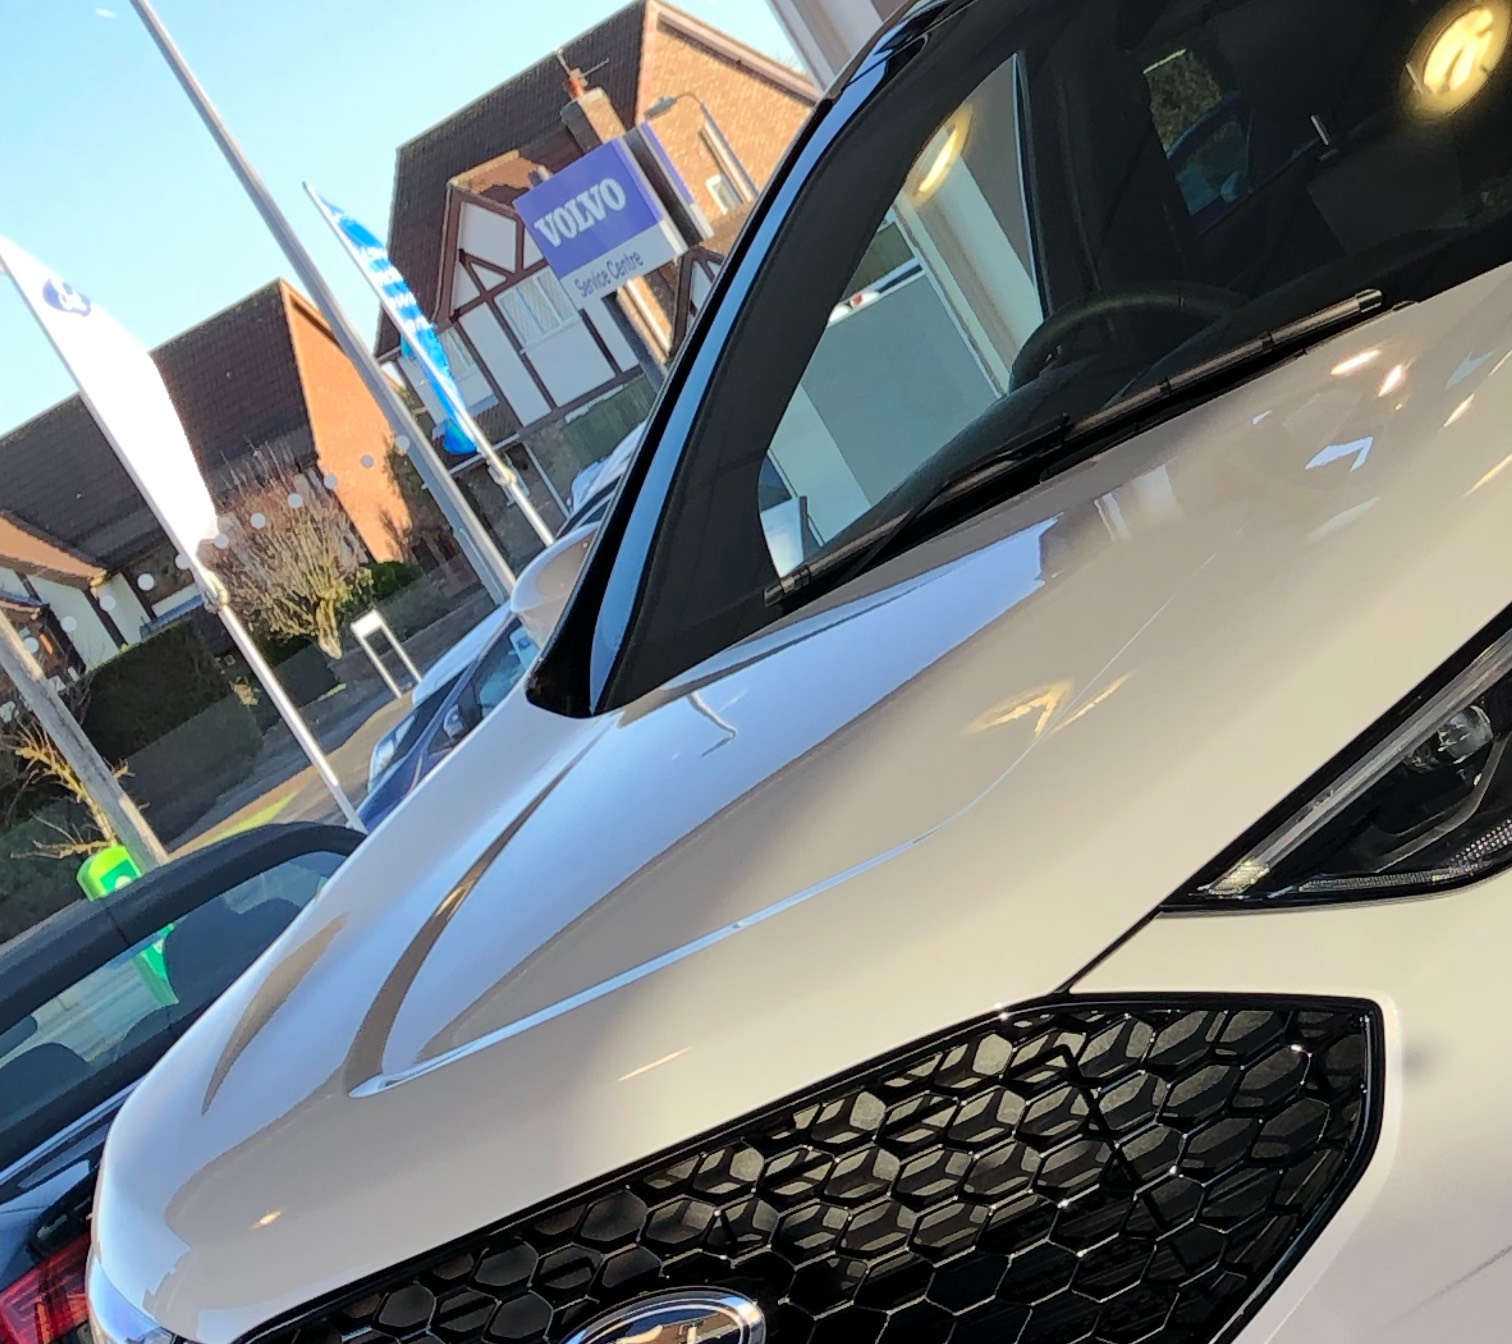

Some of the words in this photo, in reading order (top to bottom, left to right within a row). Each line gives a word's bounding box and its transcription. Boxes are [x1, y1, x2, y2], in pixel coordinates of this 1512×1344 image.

[533, 177, 626, 247] VOLVO
[574, 268, 612, 297] Service
[606, 252, 644, 279] Centre
